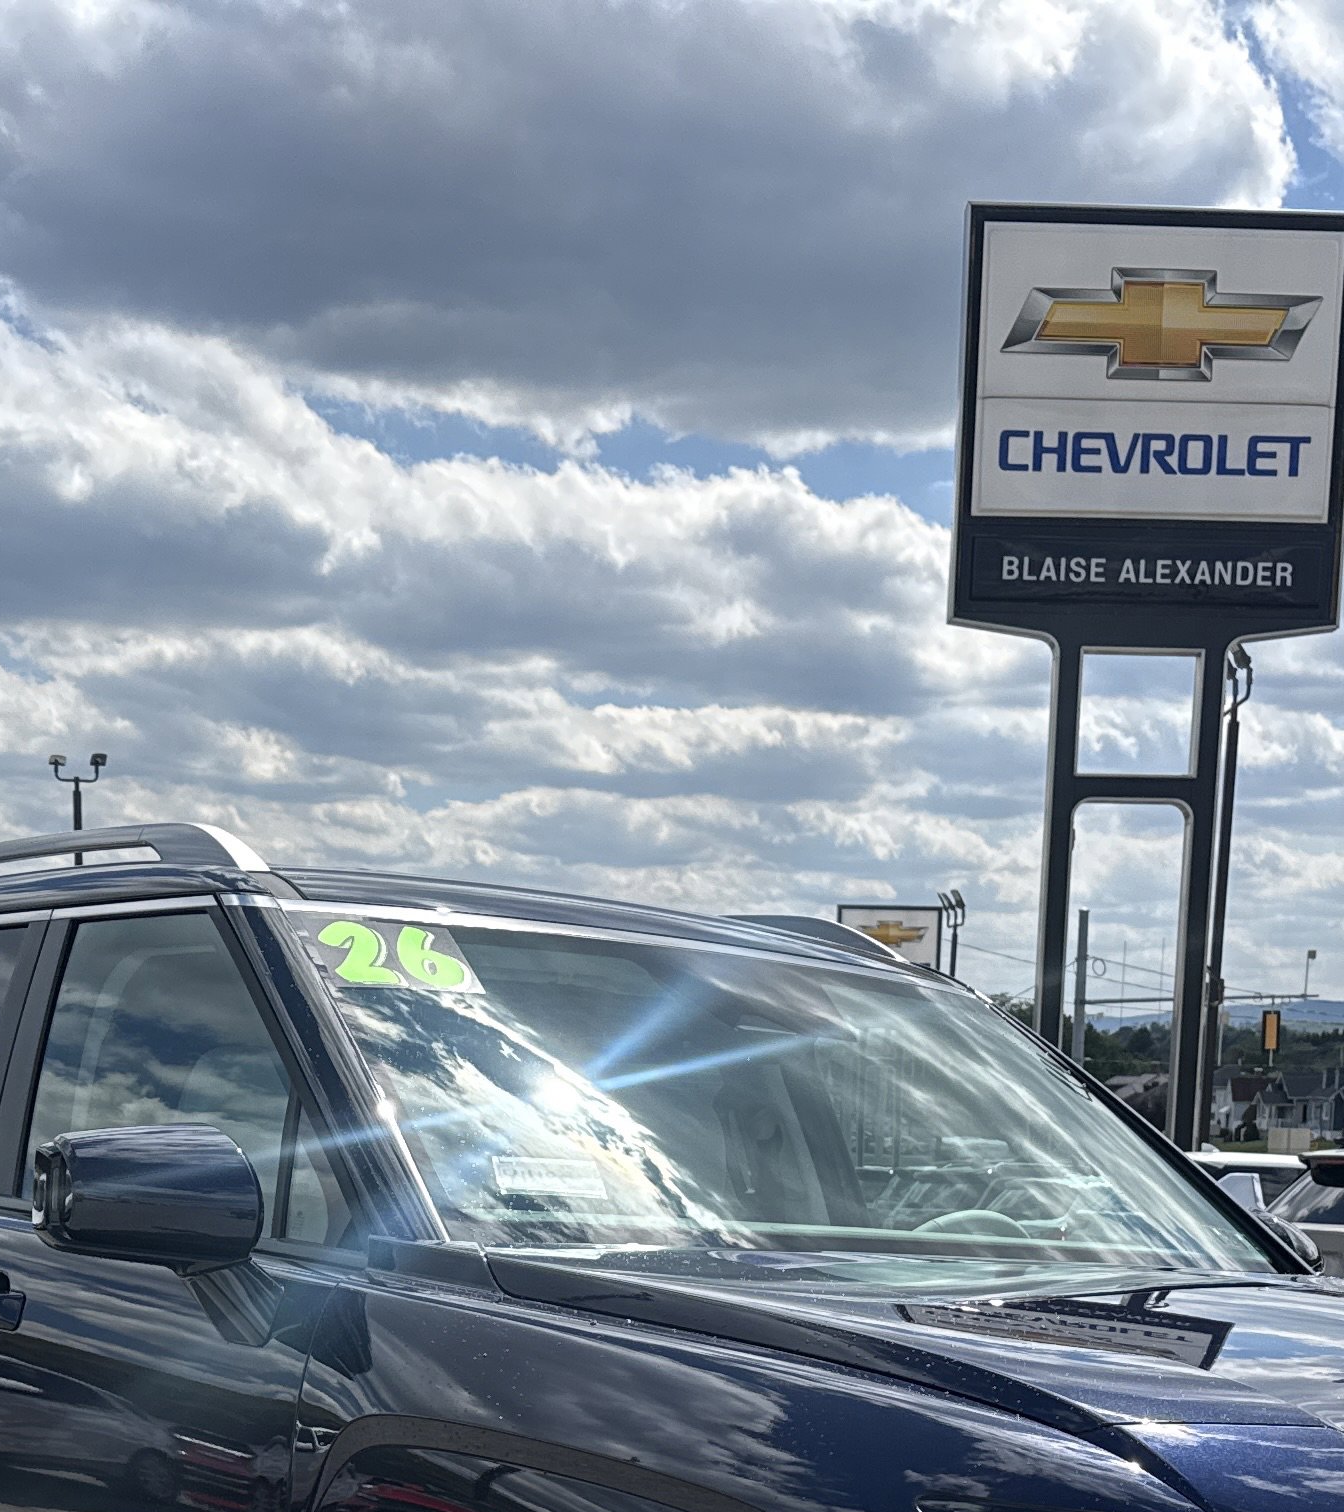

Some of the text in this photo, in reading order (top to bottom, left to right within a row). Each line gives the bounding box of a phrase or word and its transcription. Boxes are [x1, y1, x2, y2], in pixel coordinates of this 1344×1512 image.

[998, 430, 1312, 477] CHEVROLET
[1001, 555, 1294, 587] BLAISE ALEXANDER
[317, 920, 471, 989] 26
